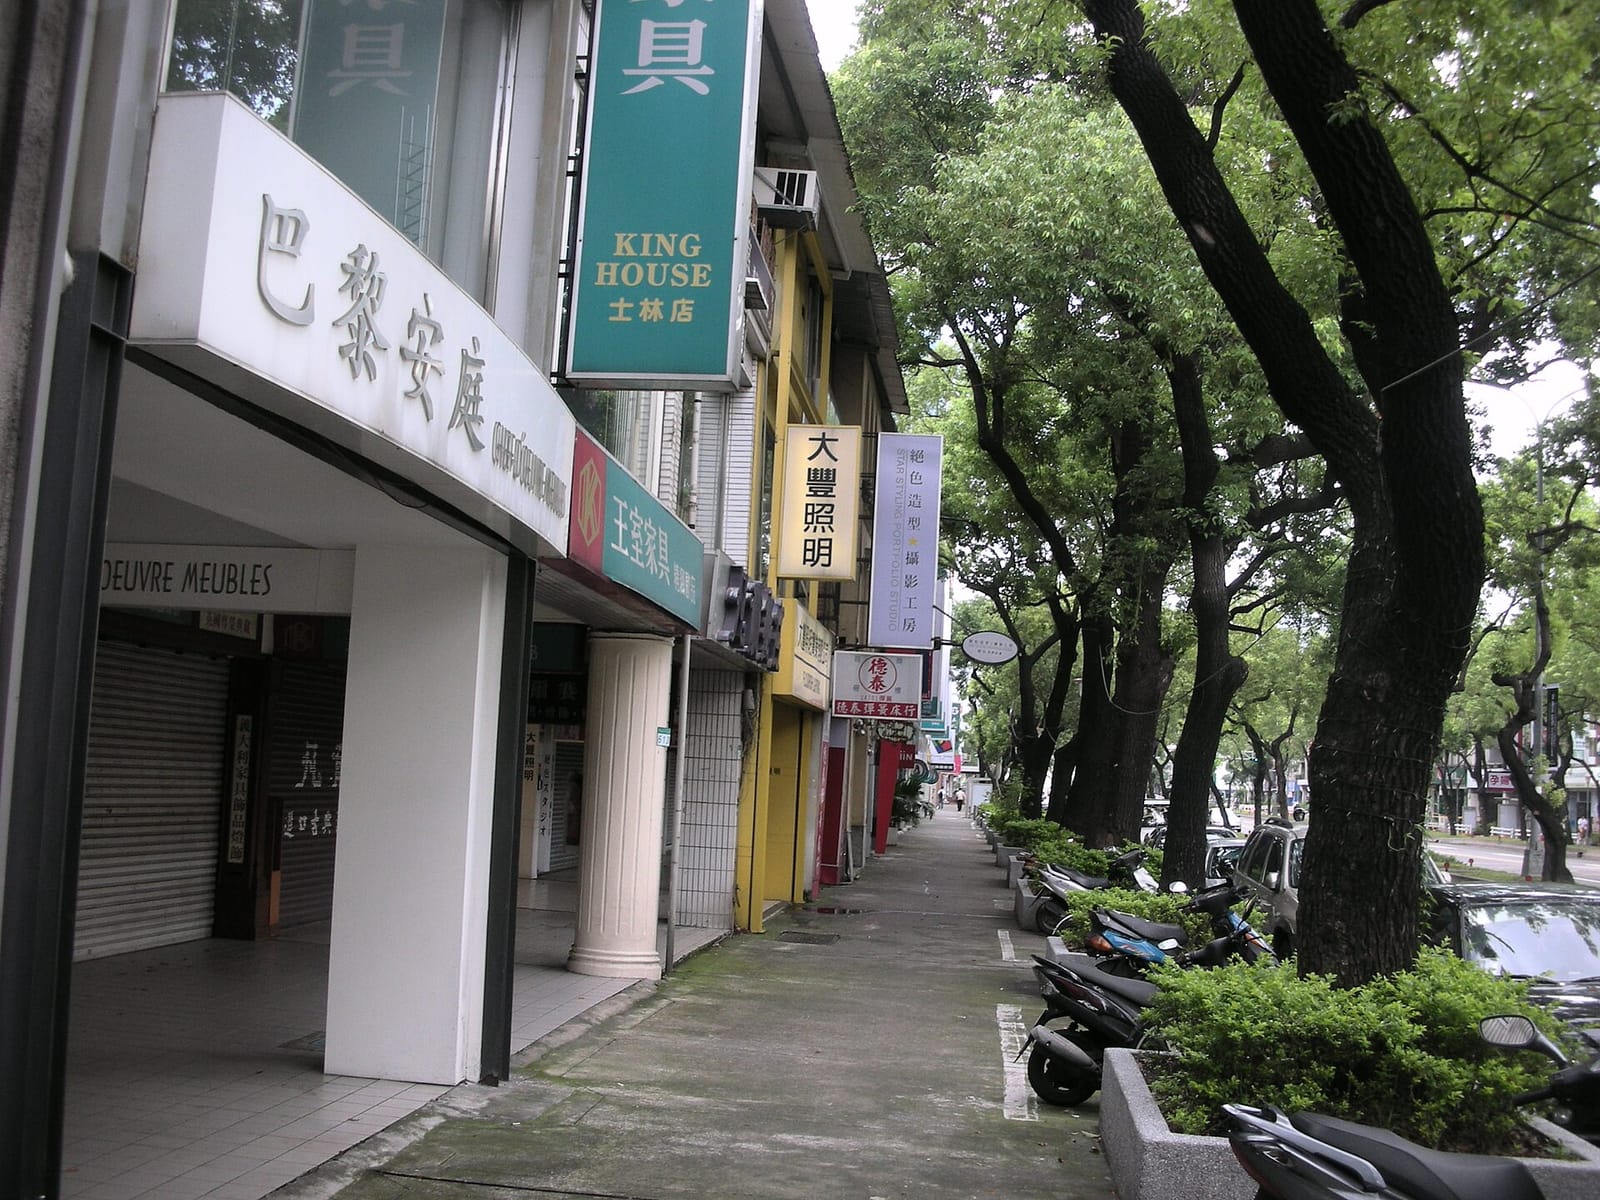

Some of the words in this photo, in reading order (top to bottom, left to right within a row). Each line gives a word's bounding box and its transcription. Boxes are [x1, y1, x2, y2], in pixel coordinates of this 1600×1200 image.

[619, 0, 715, 95] 具
[613, 233, 702, 257] KING
[594, 262, 712, 287] HOUSE
[257, 193, 486, 451] 巴黎安庭
[608, 297, 695, 323] 士林店
[802, 431, 839, 568] 大豐照明
[611, 495, 671, 586] 王室家具
[181, 562, 273, 596] MEUBLES
[868, 657, 888, 692] 德泰
[836, 702, 917, 717] 德泰彈簧床行
